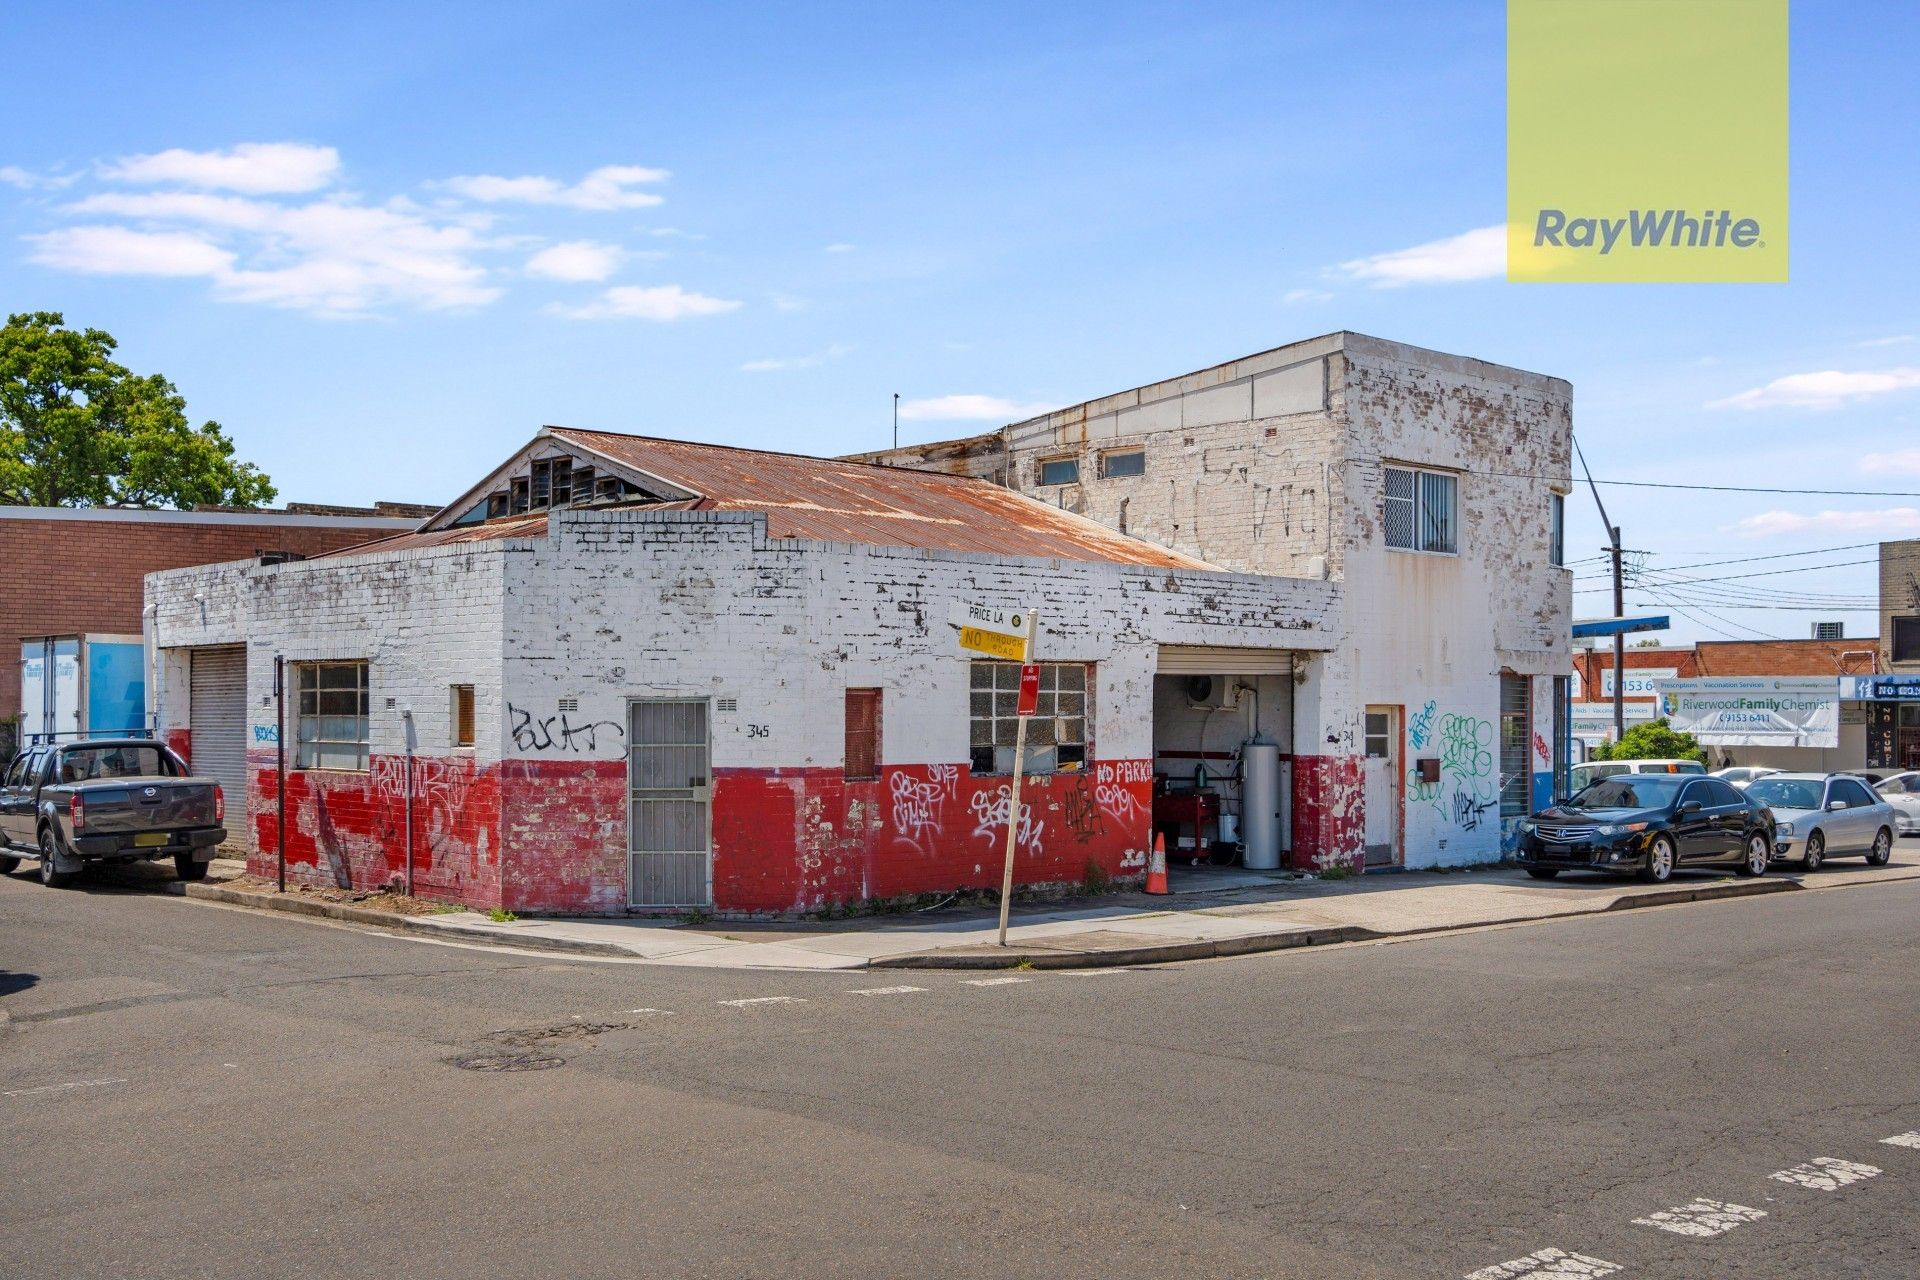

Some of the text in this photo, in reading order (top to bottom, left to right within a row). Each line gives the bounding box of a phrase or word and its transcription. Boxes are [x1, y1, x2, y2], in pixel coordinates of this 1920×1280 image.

[969, 606, 1004, 624] PRICE LA
[965, 630, 1023, 648] NO THROUGH
[993, 644, 1014, 656] ROAD
[1623, 680, 1642, 691] 153
[1682, 697, 1830, 712] RiverwoodFamilyChemist
[1726, 713, 1770, 722] 9153 6411
[747, 724, 770, 738] 345
[1096, 763, 1114, 784] NO
